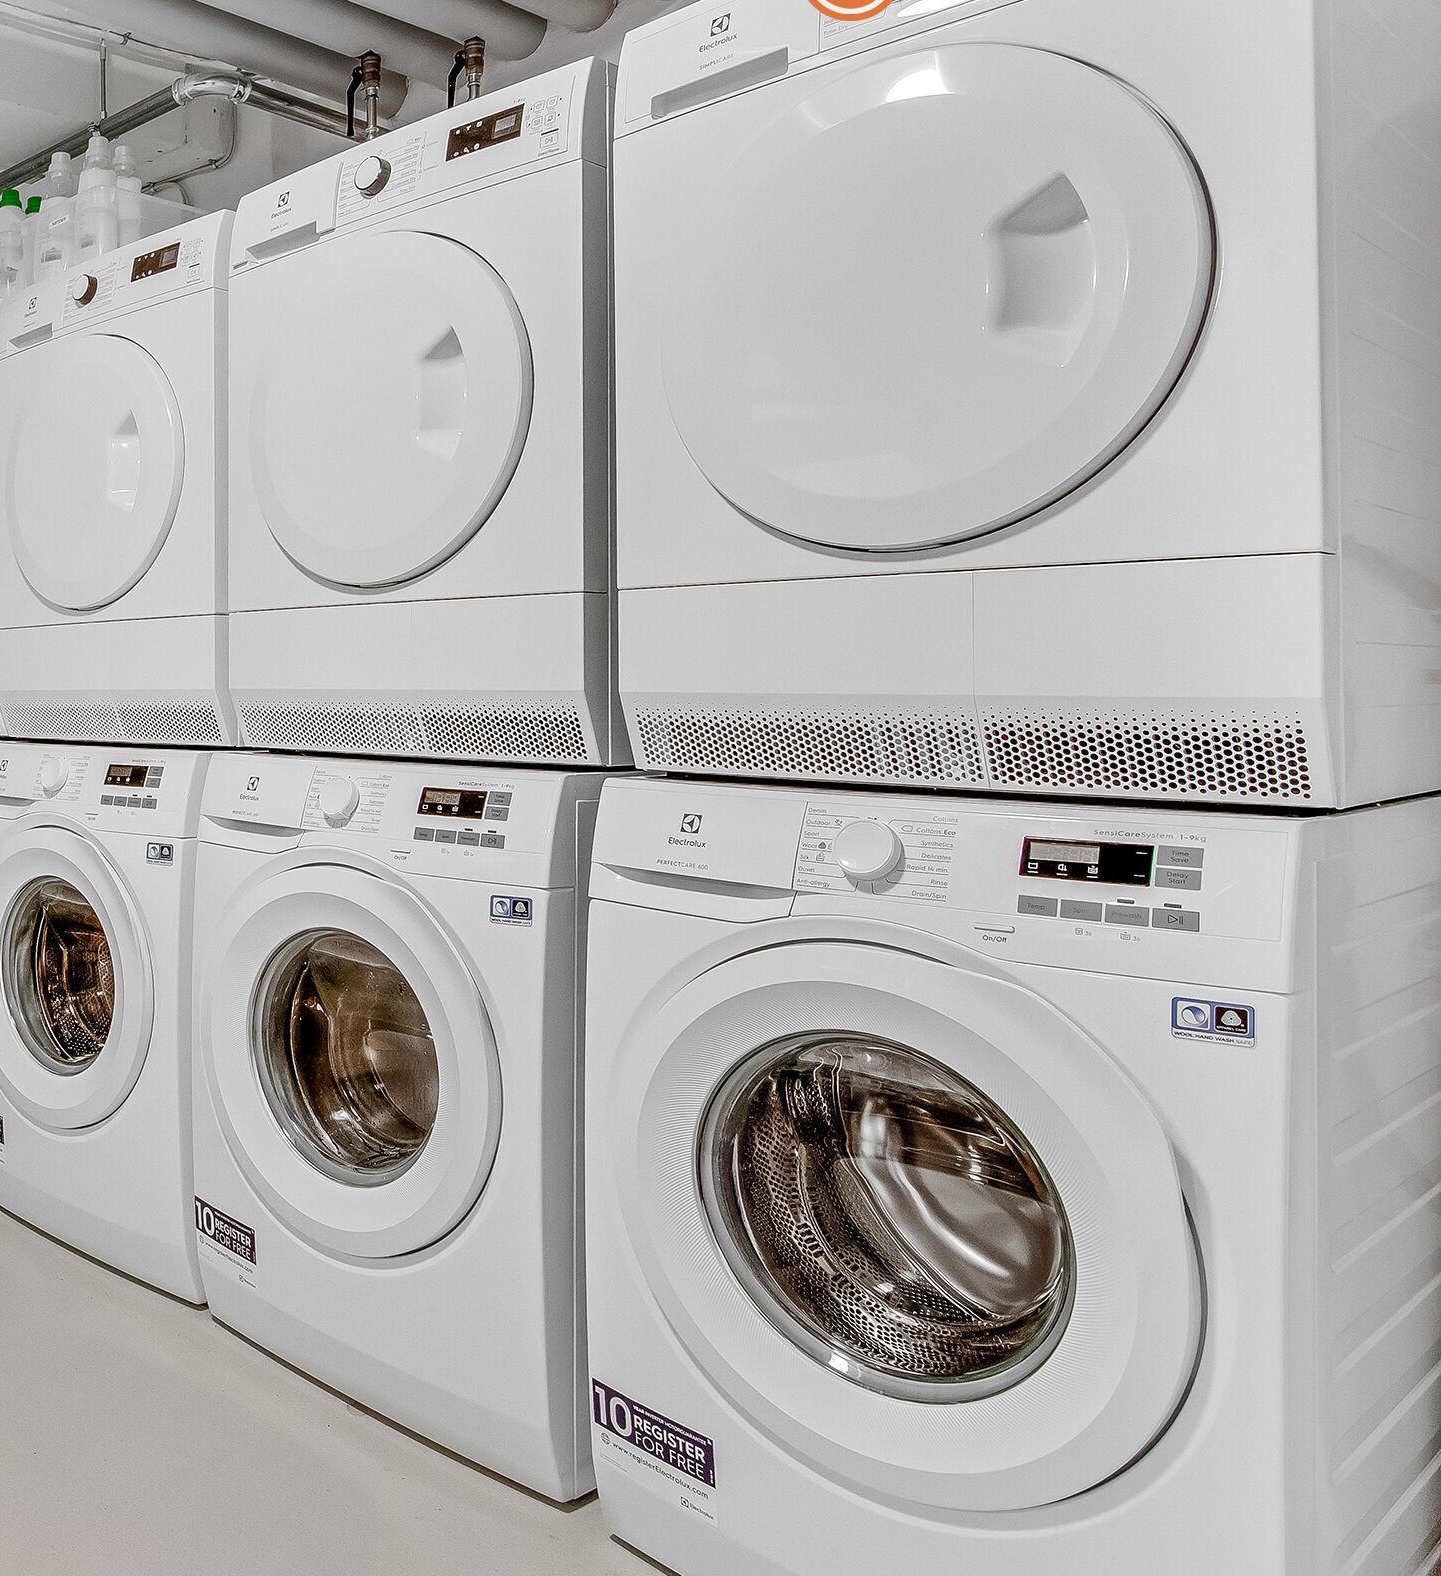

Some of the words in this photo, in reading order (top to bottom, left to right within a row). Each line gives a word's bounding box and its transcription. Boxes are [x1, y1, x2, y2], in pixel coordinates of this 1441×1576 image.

[698, 33, 738, 53] Electrolux
[806, 818, 831, 826] Outdoor
[932, 815, 959, 824] Cottons
[916, 827, 942, 836] Cottons
[1093, 828, 1174, 840] SensiCareSystem
[668, 837, 707, 848] Electrolux
[920, 840, 954, 848] Synthetics
[920, 852, 952, 861] Delicates
[656, 859, 696, 869] PERFECTCARE
[906, 863, 926, 872] Rapid
[1166, 871, 1189, 879] Delay
[930, 878, 949, 887] Rinse
[911, 889, 947, 899] Drain/Spin
[982, 934, 1007, 943] On/Off
[1173, 1030, 1194, 1038] WOOL
[1194, 1033, 1214, 1041] HAND
[196, 1200, 215, 1236] 10
[215, 1217, 252, 1248] REGISTER
[215, 1231, 231, 1249] FOR
[233, 1240, 252, 1260] FREE
[594, 1385, 633, 1437] 10
[632, 1404, 645, 1415] YEAR
[633, 1414, 706, 1464] REGISTER
[635, 1431, 665, 1459] FOR
[669, 1450, 705, 1480] FREE
[612, 1442, 709, 1500] www.registerElectrolux.com
